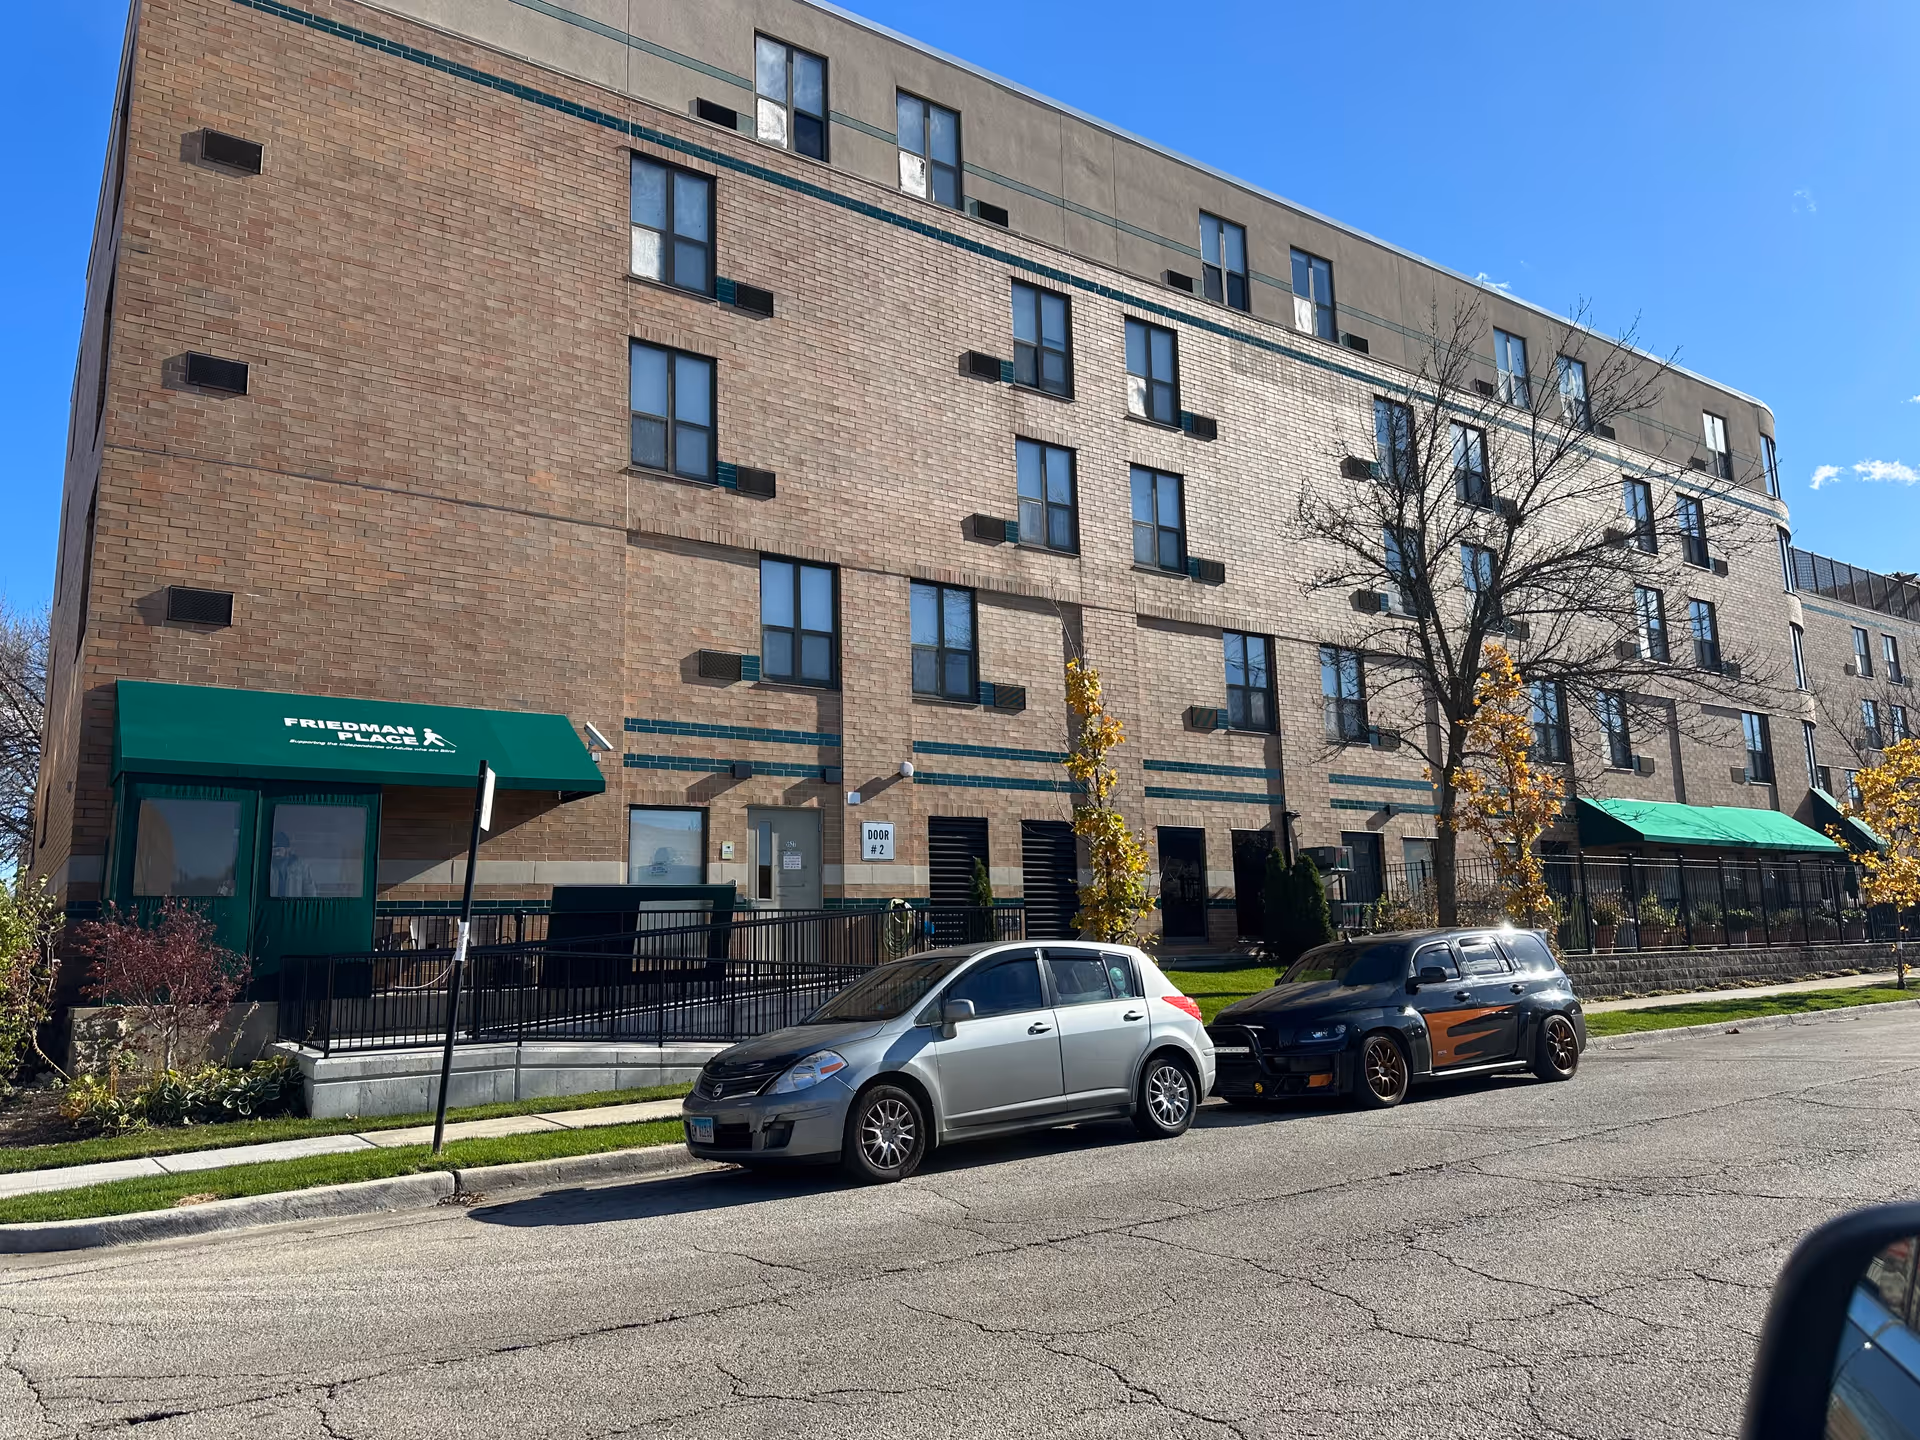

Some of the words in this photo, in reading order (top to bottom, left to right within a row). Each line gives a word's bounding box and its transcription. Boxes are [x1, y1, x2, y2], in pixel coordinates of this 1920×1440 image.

[283, 717, 415, 736] FRIEDMAN
[289, 738, 326, 746] Supporting
[337, 731, 420, 746] PLACE
[867, 829, 890, 841] DOOR
